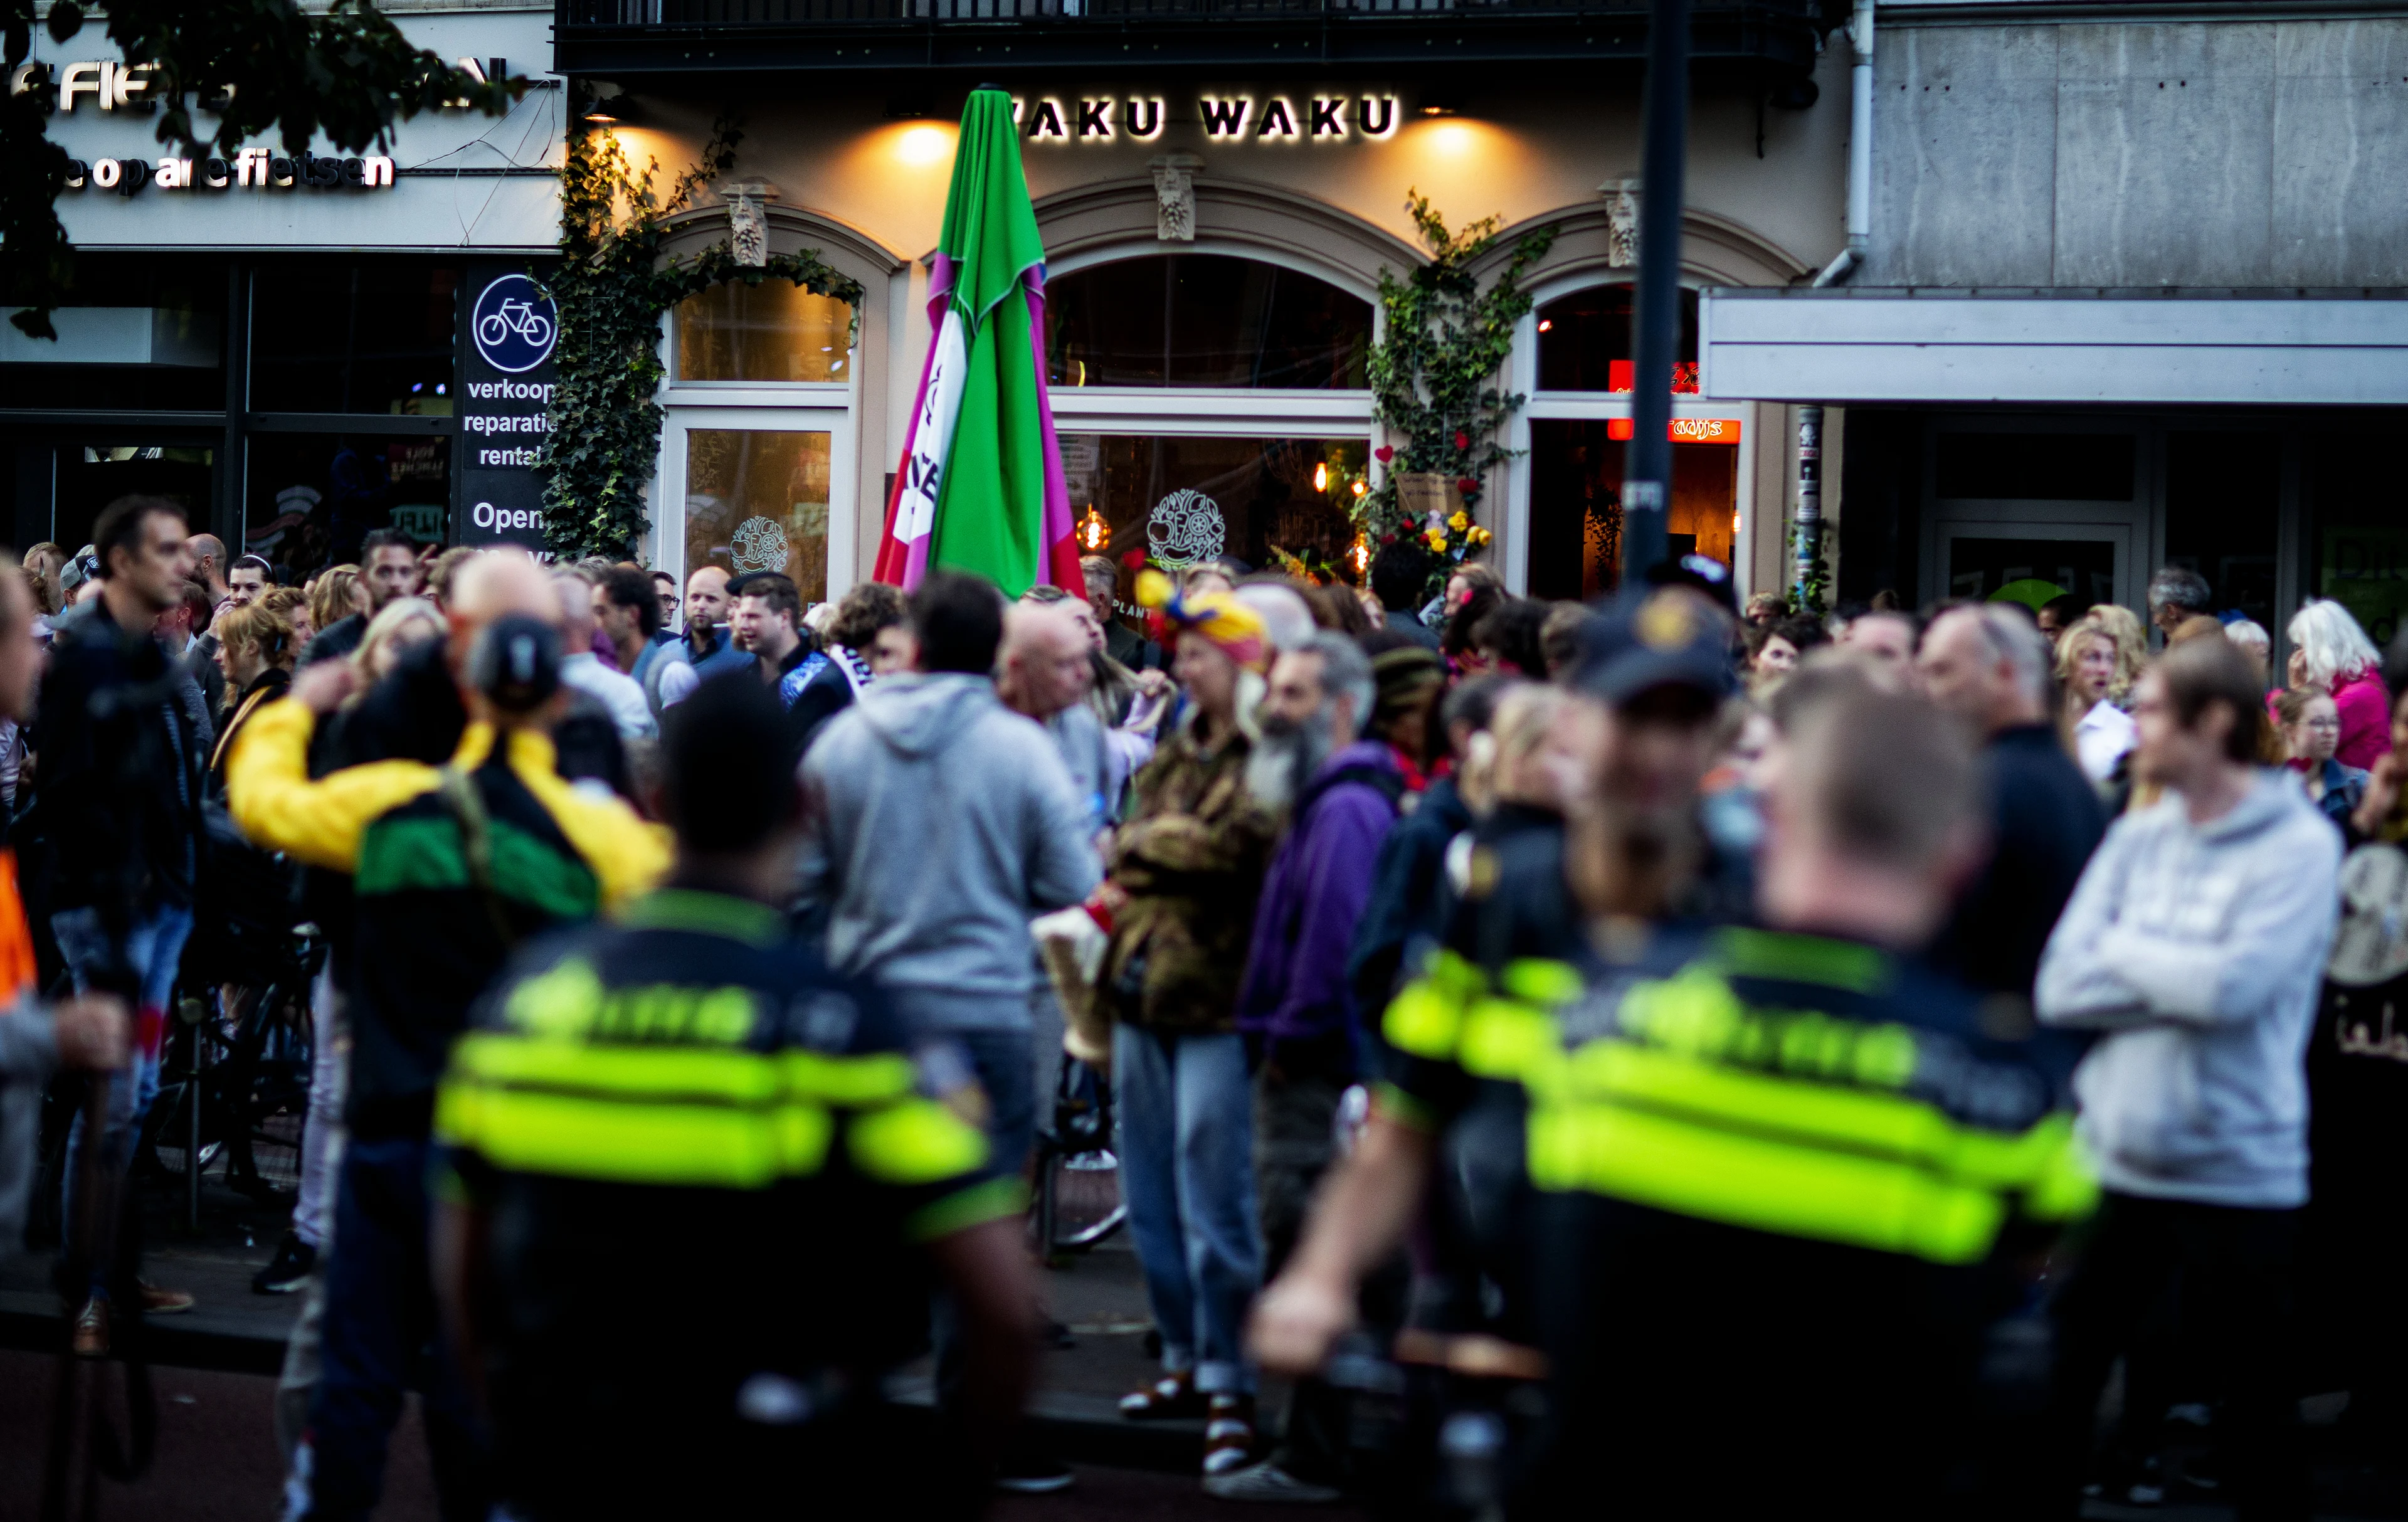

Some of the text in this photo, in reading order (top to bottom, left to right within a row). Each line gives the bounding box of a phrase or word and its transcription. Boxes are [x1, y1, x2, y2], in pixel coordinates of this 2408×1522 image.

[1011, 98, 1395, 137] AKU WAKU
[93, 158, 148, 197] op
[237, 147, 395, 189] fietsen
[480, 446, 542, 465] rental
[1112, 598, 1152, 620] PLANT
